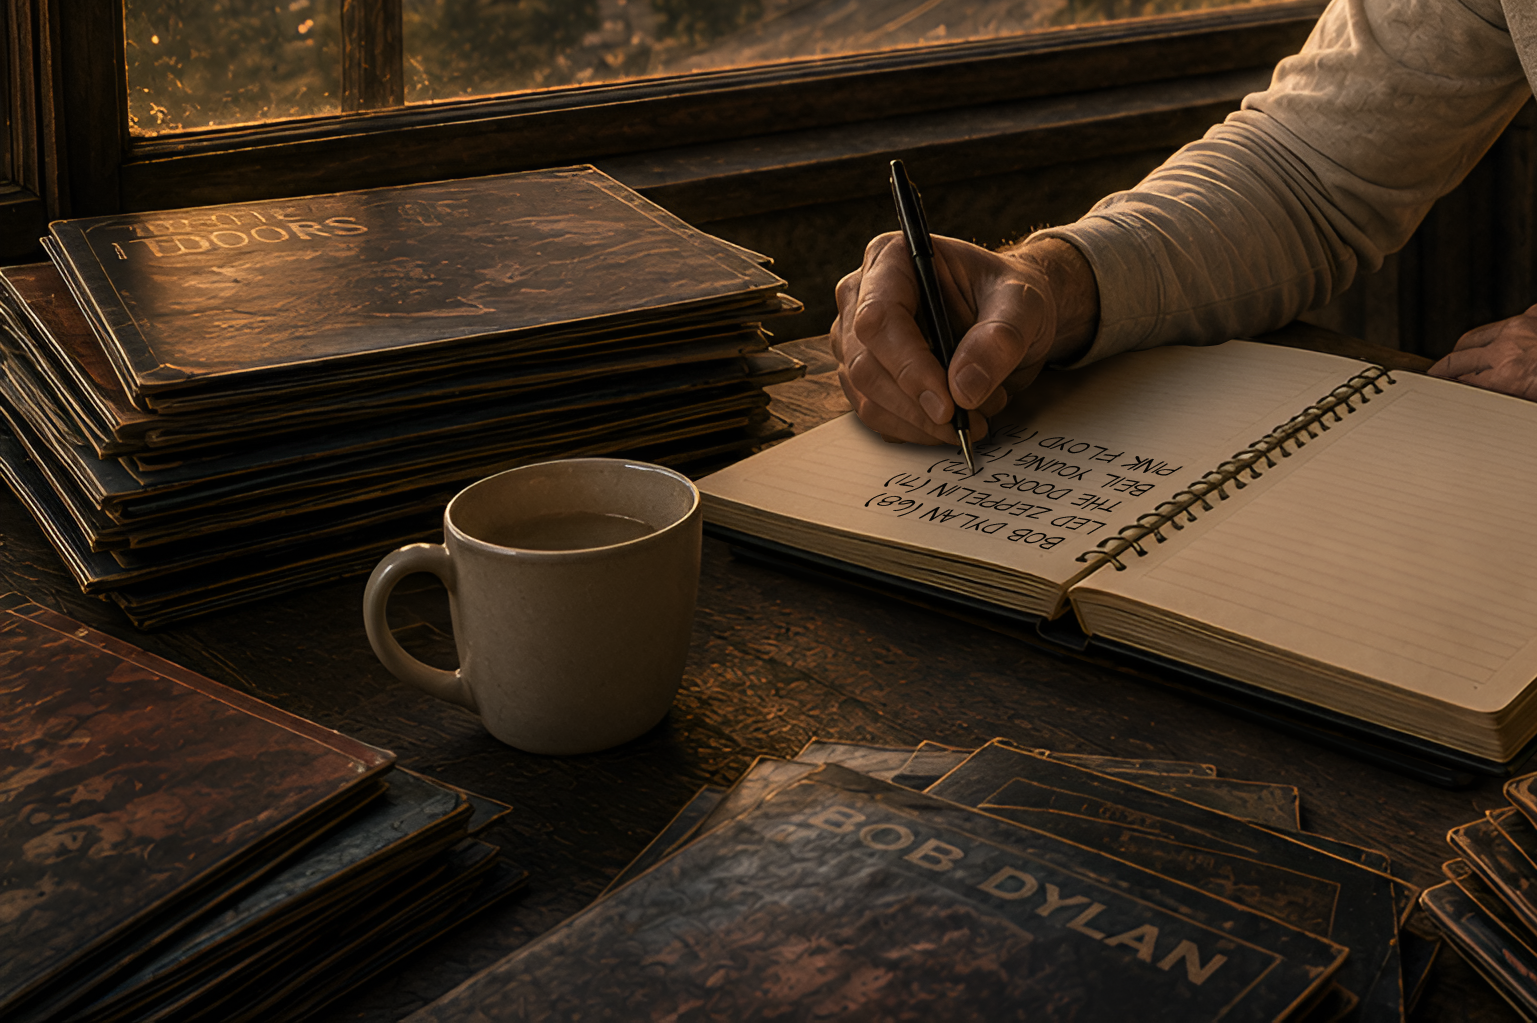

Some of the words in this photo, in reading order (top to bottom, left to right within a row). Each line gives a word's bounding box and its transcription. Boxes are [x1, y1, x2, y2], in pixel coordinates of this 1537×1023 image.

[1037, 435, 1126, 464] FLOYD
[1014, 452, 1094, 482] YOUNG
[1121, 455, 1184, 477] PINK
[883, 472, 931, 494] (71)
[983, 471, 1074, 501] DOORS
[864, 492, 924, 518] (68)
[926, 481, 1053, 520] ZEPPELIN
[1071, 492, 1123, 513] THE
[919, 505, 1009, 535] DYLAN
[1050, 513, 1108, 535] LED
[1006, 527, 1066, 550] BOB
[808, 805, 965, 872] BOB
[976, 865, 1229, 987] DYLAN
